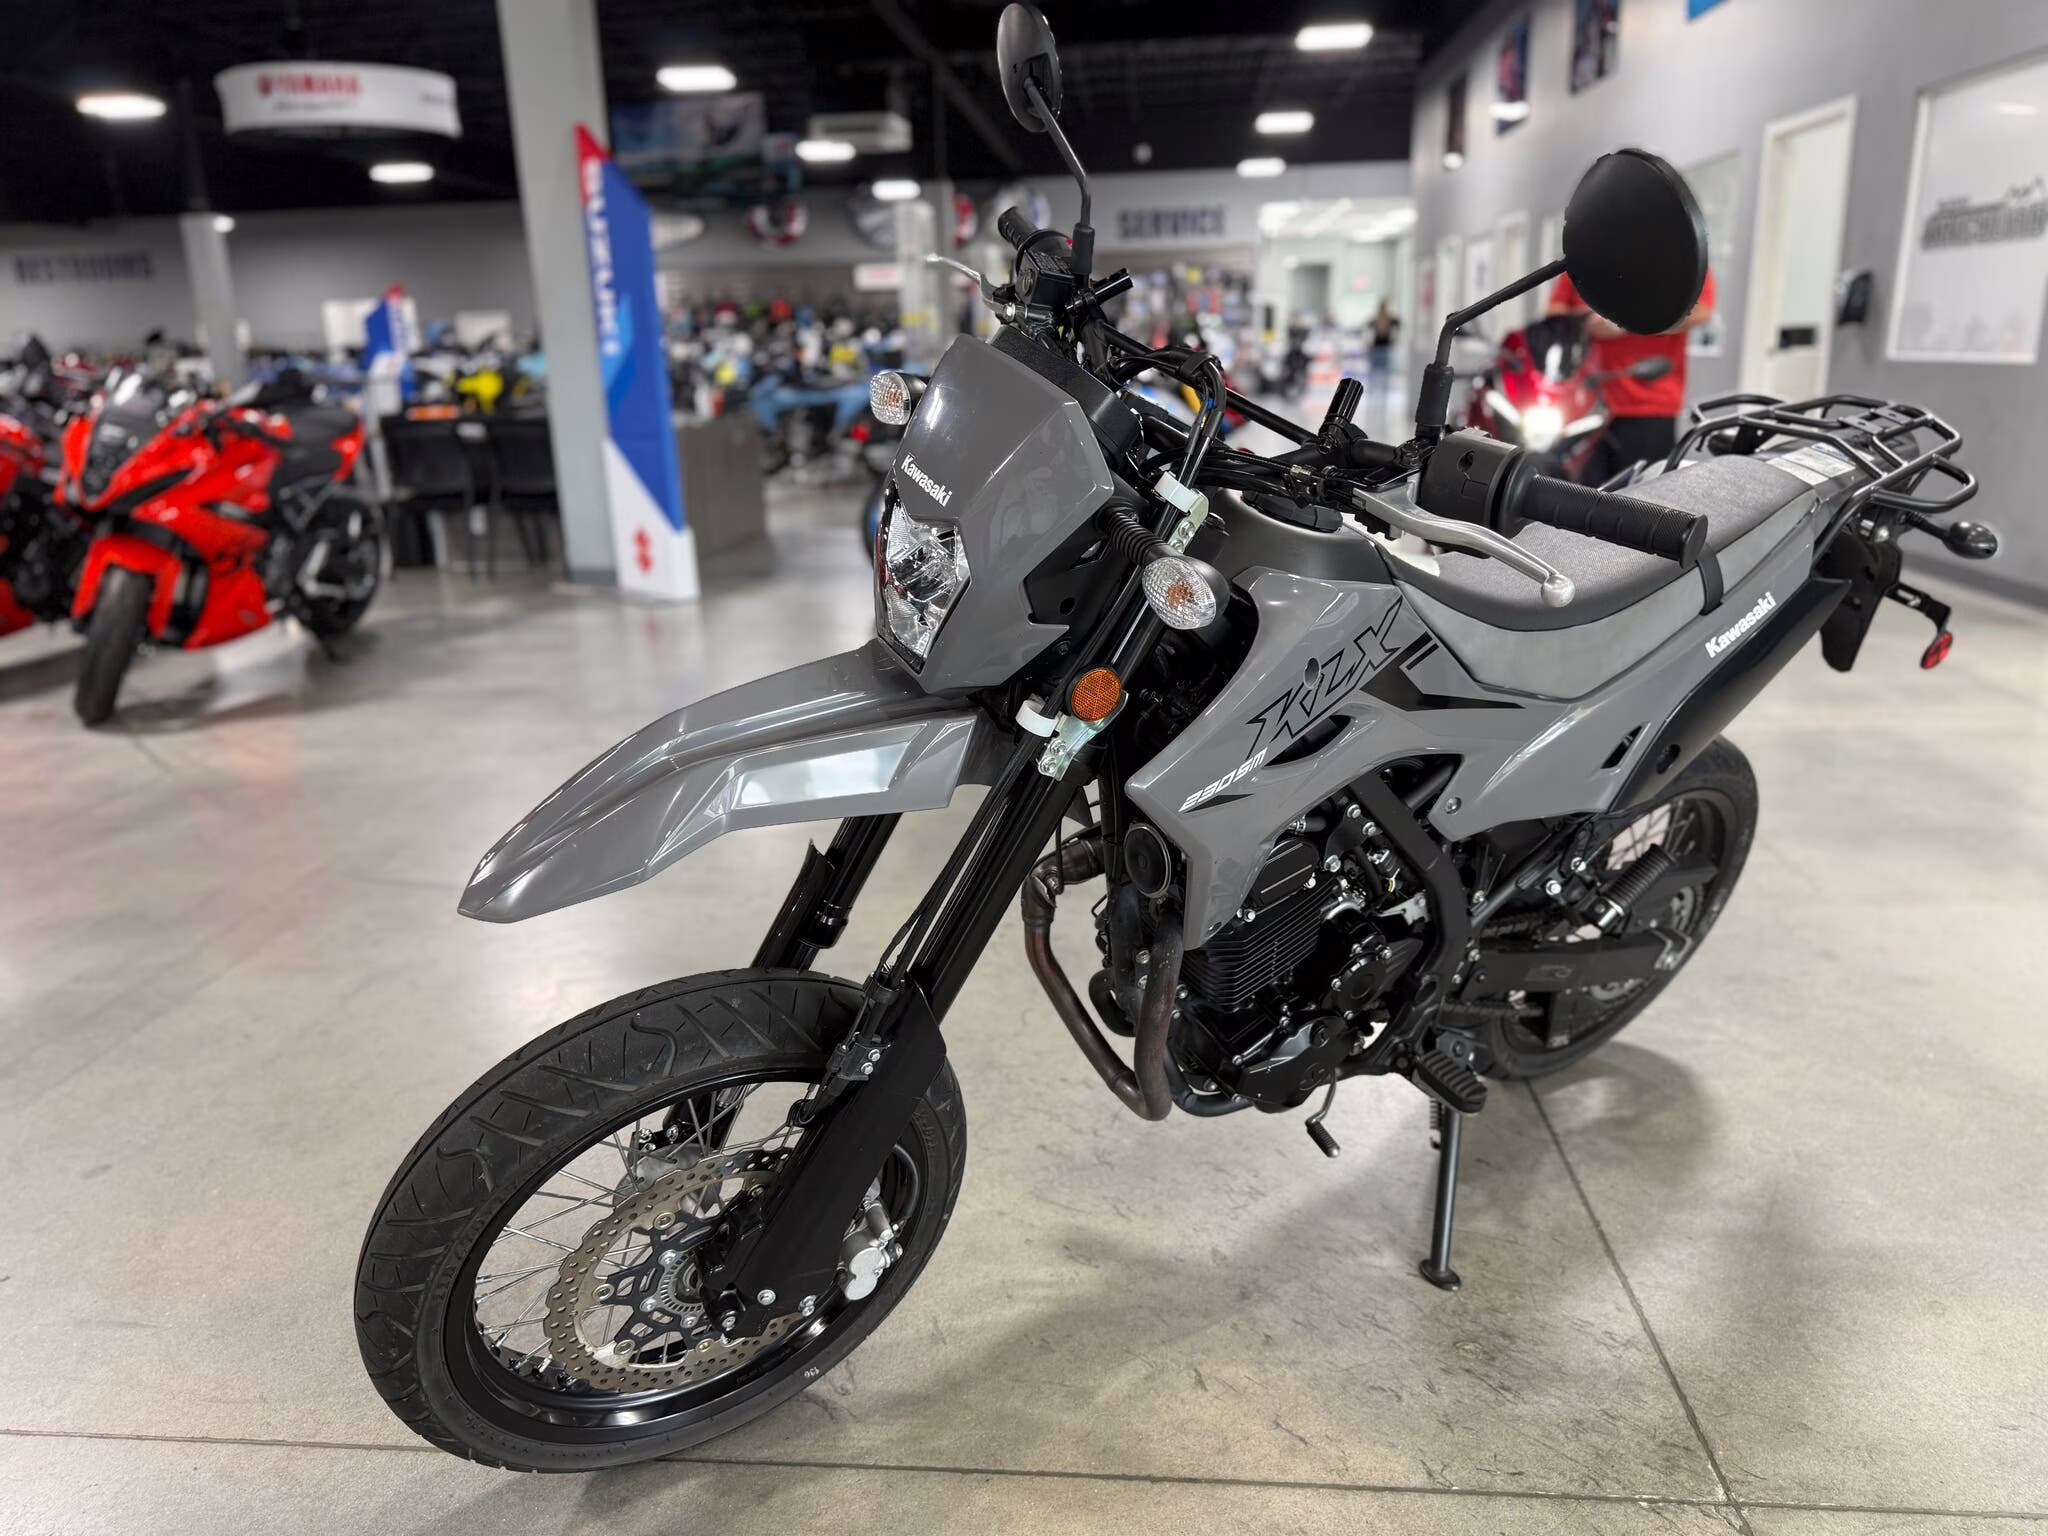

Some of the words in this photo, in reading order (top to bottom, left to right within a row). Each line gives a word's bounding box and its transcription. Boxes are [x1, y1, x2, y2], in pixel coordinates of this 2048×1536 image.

[1119, 206, 1225, 239] SERVICE
[901, 454, 953, 507] Kawasaki
[1705, 591, 1777, 658] Kawasaki
